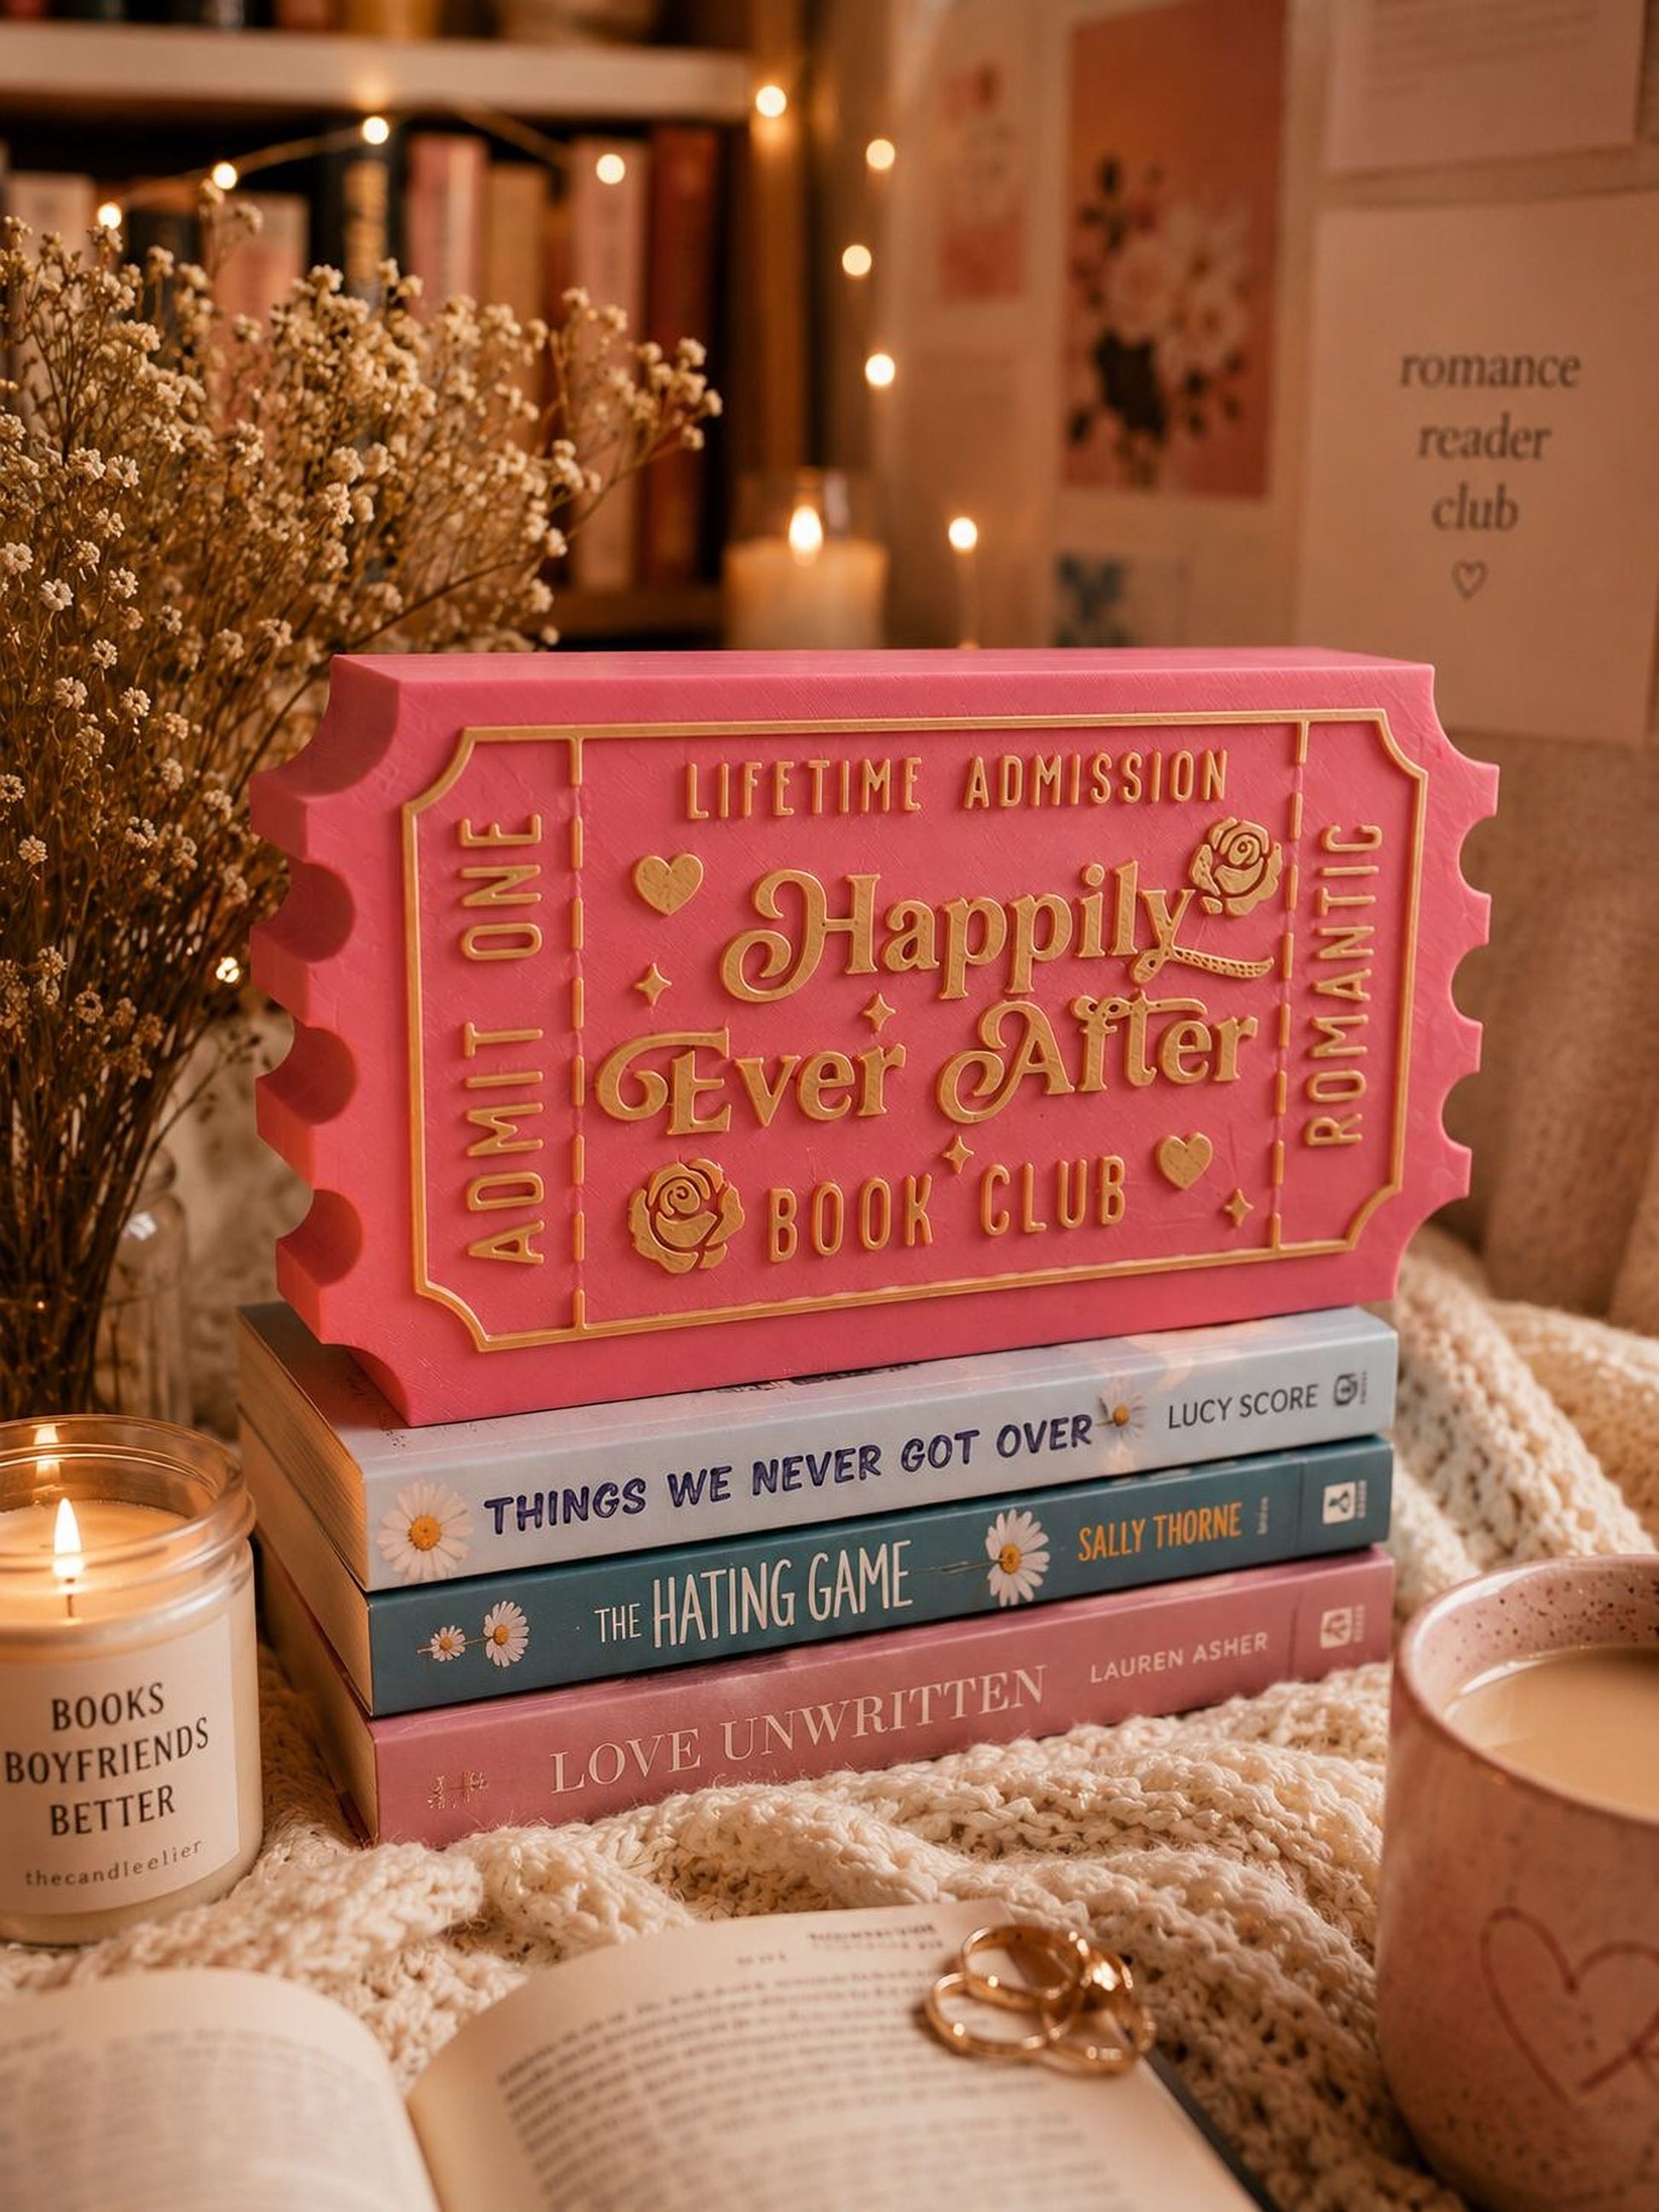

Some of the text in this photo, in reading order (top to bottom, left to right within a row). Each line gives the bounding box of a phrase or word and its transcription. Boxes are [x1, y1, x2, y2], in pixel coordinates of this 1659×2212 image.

[1400, 353, 1581, 388] romance
[1418, 411, 1552, 459] reader
[1431, 481, 1520, 531] club
[686, 748, 1228, 820] LIFETIME ADMISSION
[720, 860, 1275, 1002] Happily
[1306, 824, 1383, 1146] ROMANTIC
[458, 813, 545, 1264] ADMIT ONE
[595, 991, 1258, 1135] Ever After
[767, 1155, 1125, 1262] BOOK CLUB
[1169, 1394, 1233, 1430] LUCY
[1240, 1383, 1319, 1419] SCORE
[483, 1413, 1093, 1535] THINGS WE NEVER GOT OVER
[1077, 1518, 1145, 1562] SALLY
[1152, 1502, 1243, 1553] THORNE
[594, 1539, 914, 1649] THE HATING GAME
[1090, 1632, 1268, 1684] LAUREN ASHER
[51, 1681, 165, 1731] BOOKS
[550, 1664, 1047, 1796] LOVE UNWRITTEN
[4, 1717, 210, 1784] BOYFRIENDS
[49, 1784, 176, 1836] BETTER
[25, 1838, 202, 1886] thecandleelier
